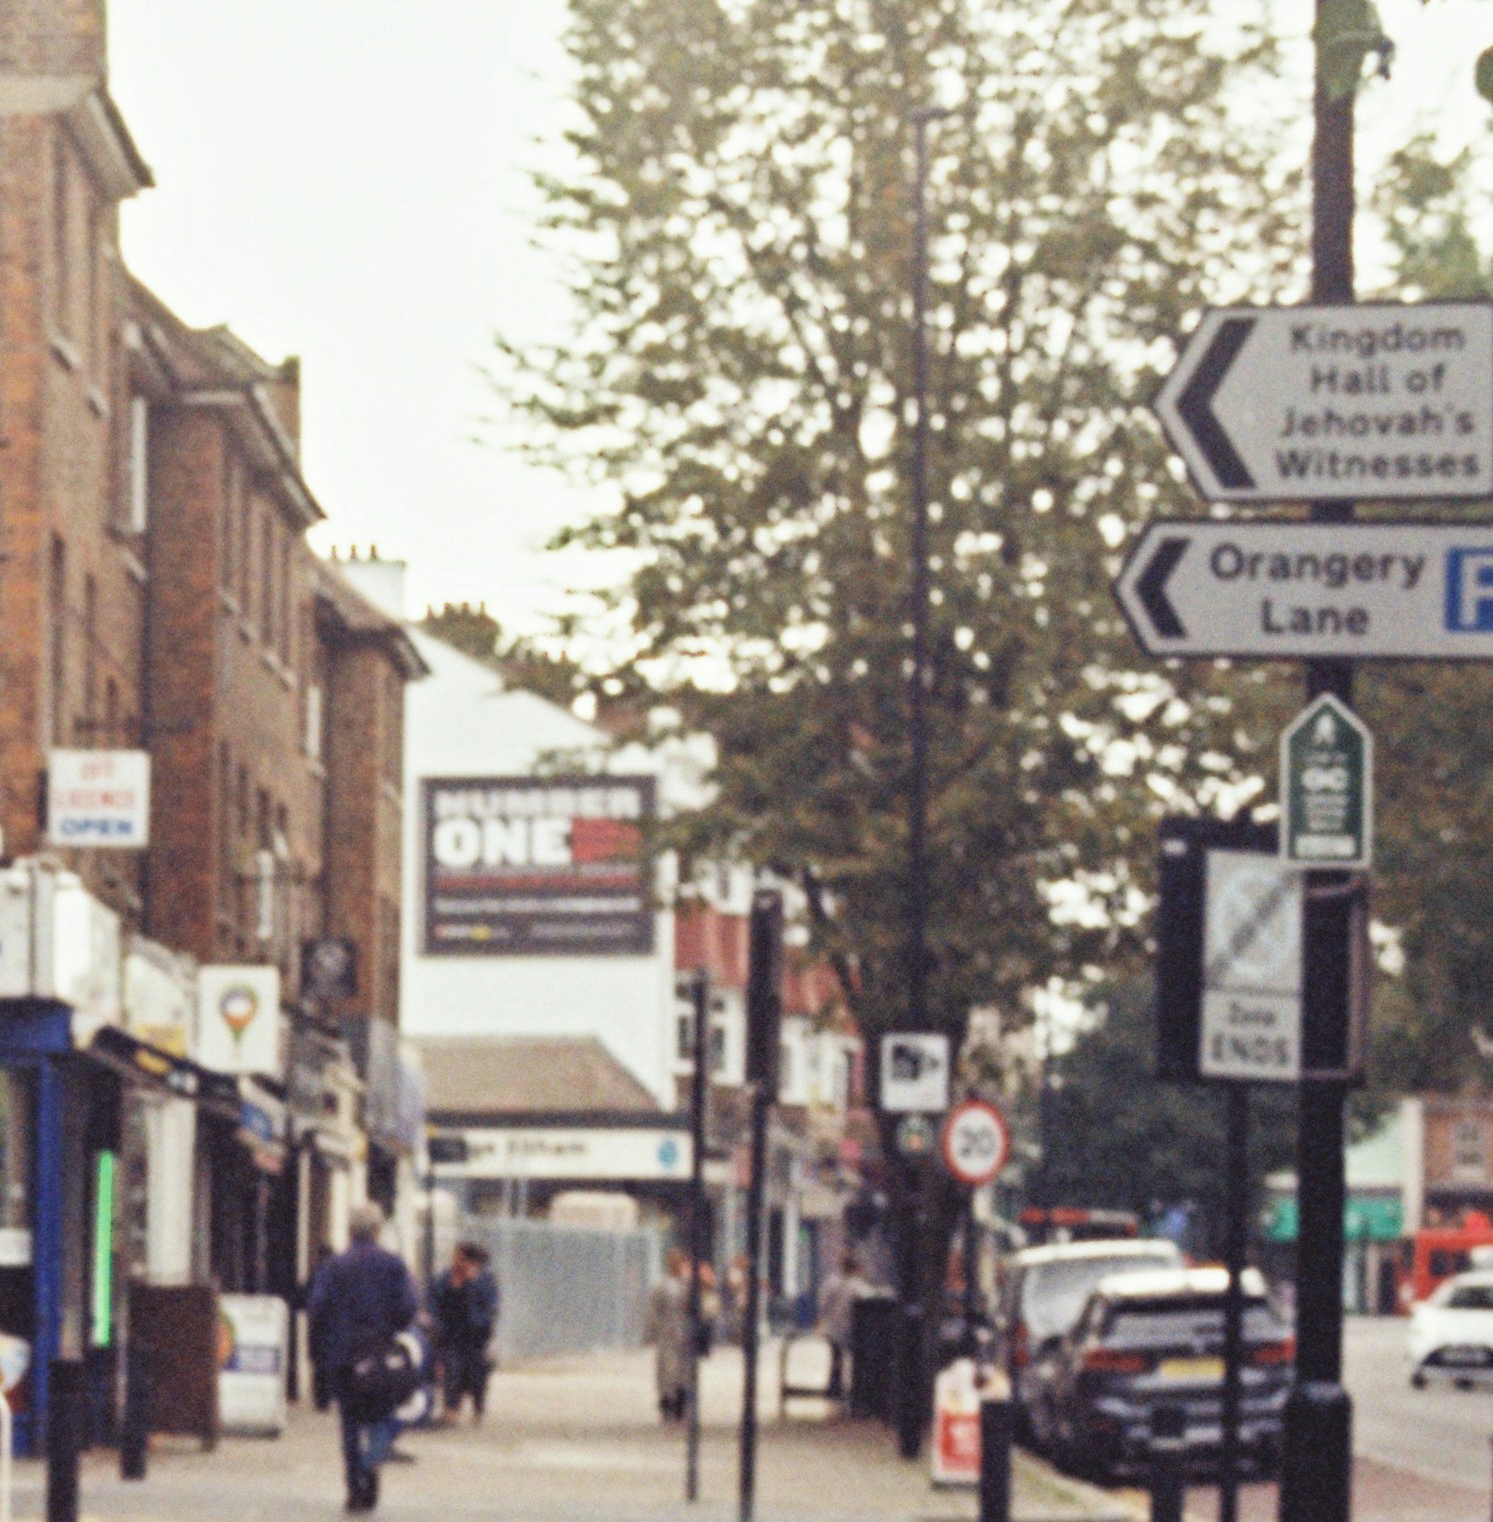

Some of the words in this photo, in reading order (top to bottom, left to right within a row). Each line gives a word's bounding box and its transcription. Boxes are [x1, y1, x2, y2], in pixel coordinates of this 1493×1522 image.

[1289, 323, 1466, 359] Kingdom
[1311, 364, 1391, 395] Hall
[1404, 363, 1447, 394] of
[1281, 405, 1475, 438] Jehovah's
[1274, 447, 1481, 479] Witnesses
[1209, 542, 1427, 590] Orangery
[1260, 599, 1371, 636] Lane
[59, 816, 134, 837] OPEN
[432, 817, 574, 865] ONE
[1211, 1033, 1290, 1066] ENDS
